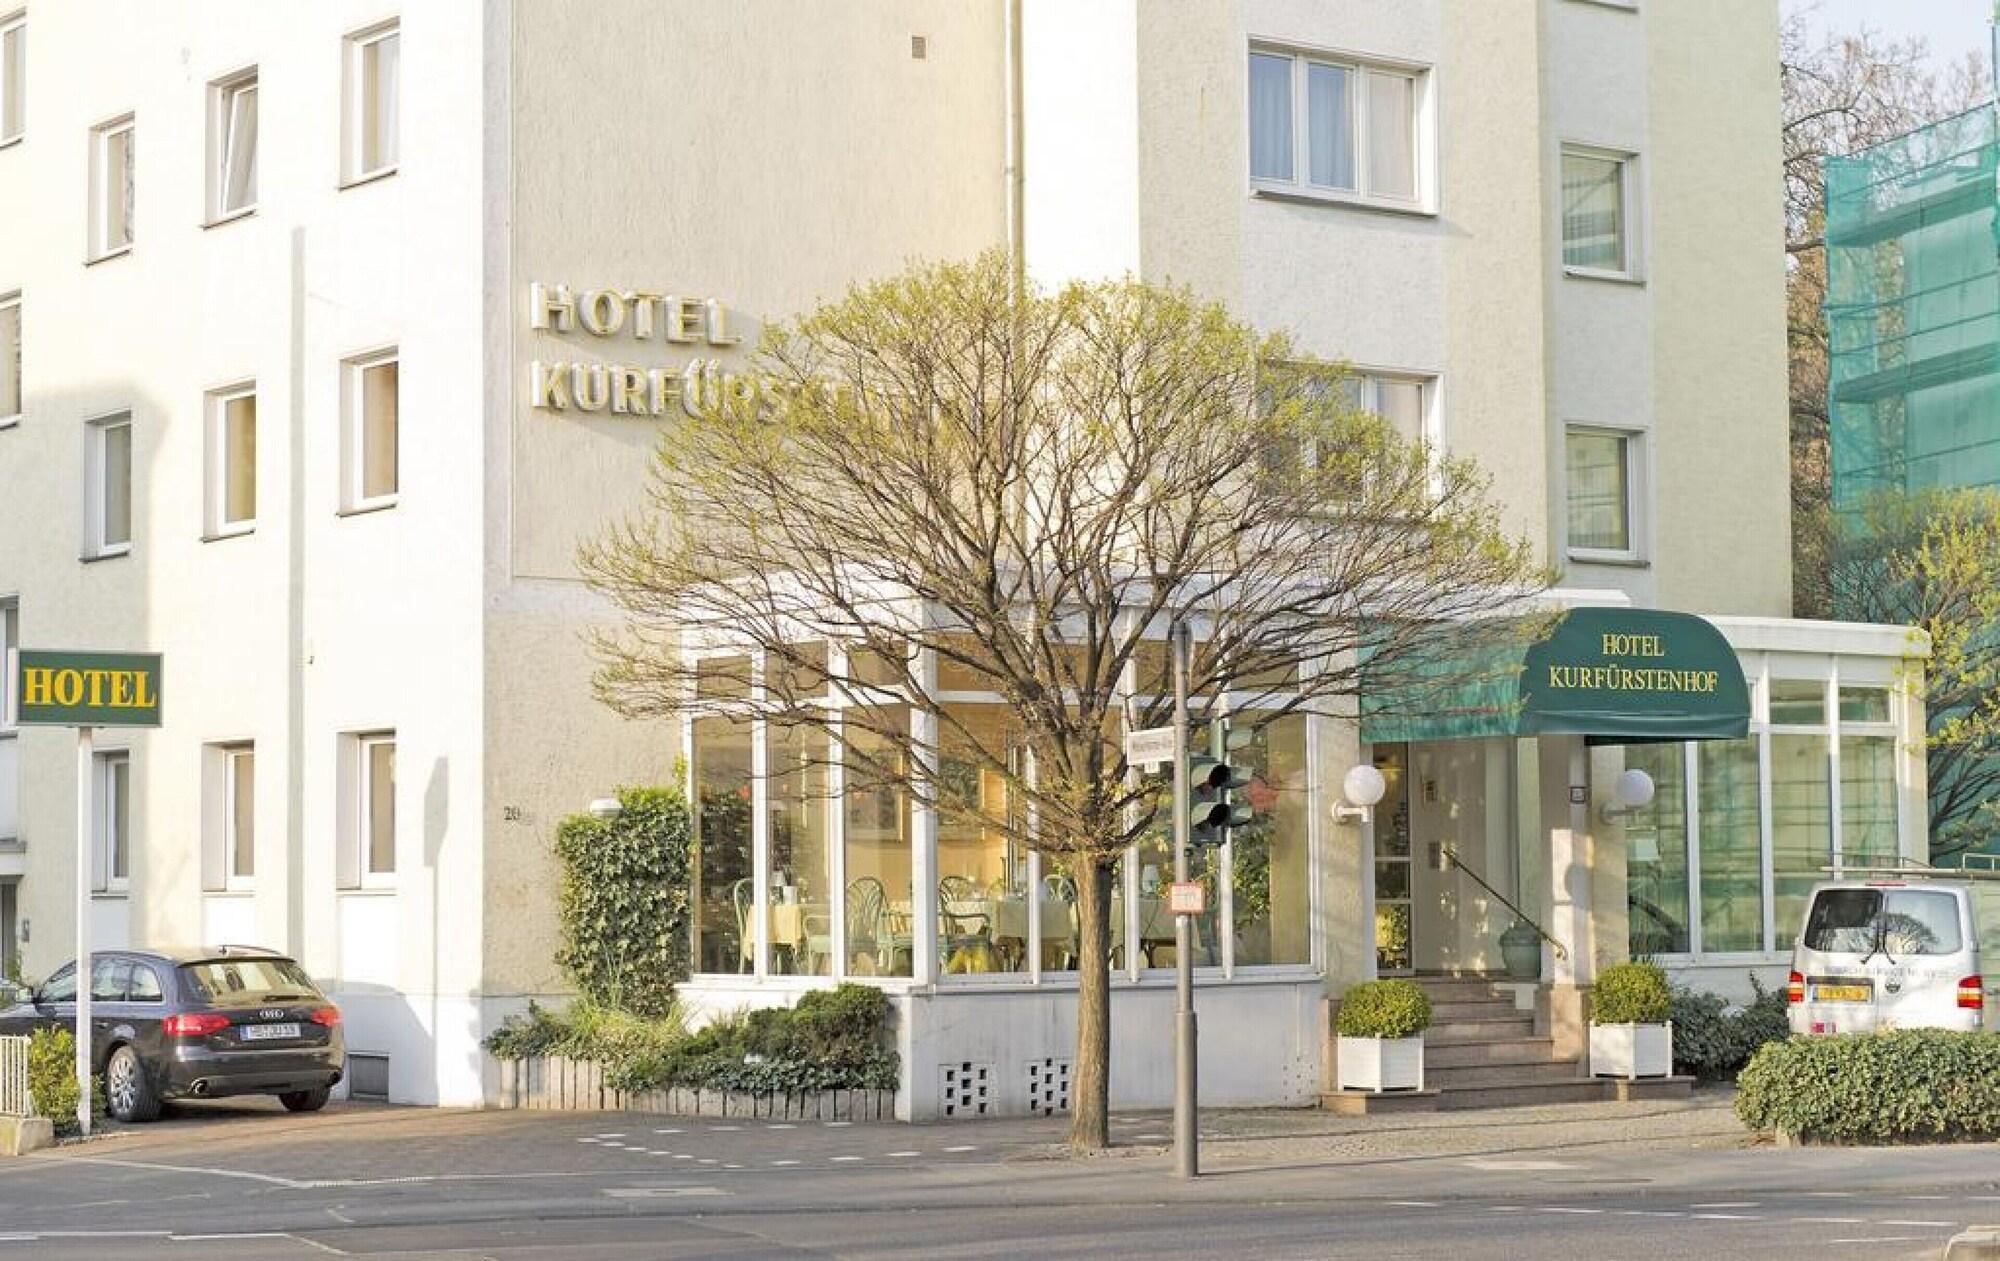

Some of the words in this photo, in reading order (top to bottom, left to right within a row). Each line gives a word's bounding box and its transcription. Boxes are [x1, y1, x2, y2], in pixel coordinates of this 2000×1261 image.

[530, 281, 743, 345] HOTEL
[1602, 633, 1664, 657] HOTEL
[23, 667, 157, 708] HOTEL
[1550, 663, 1718, 692] KURFÜRSTENHOF
